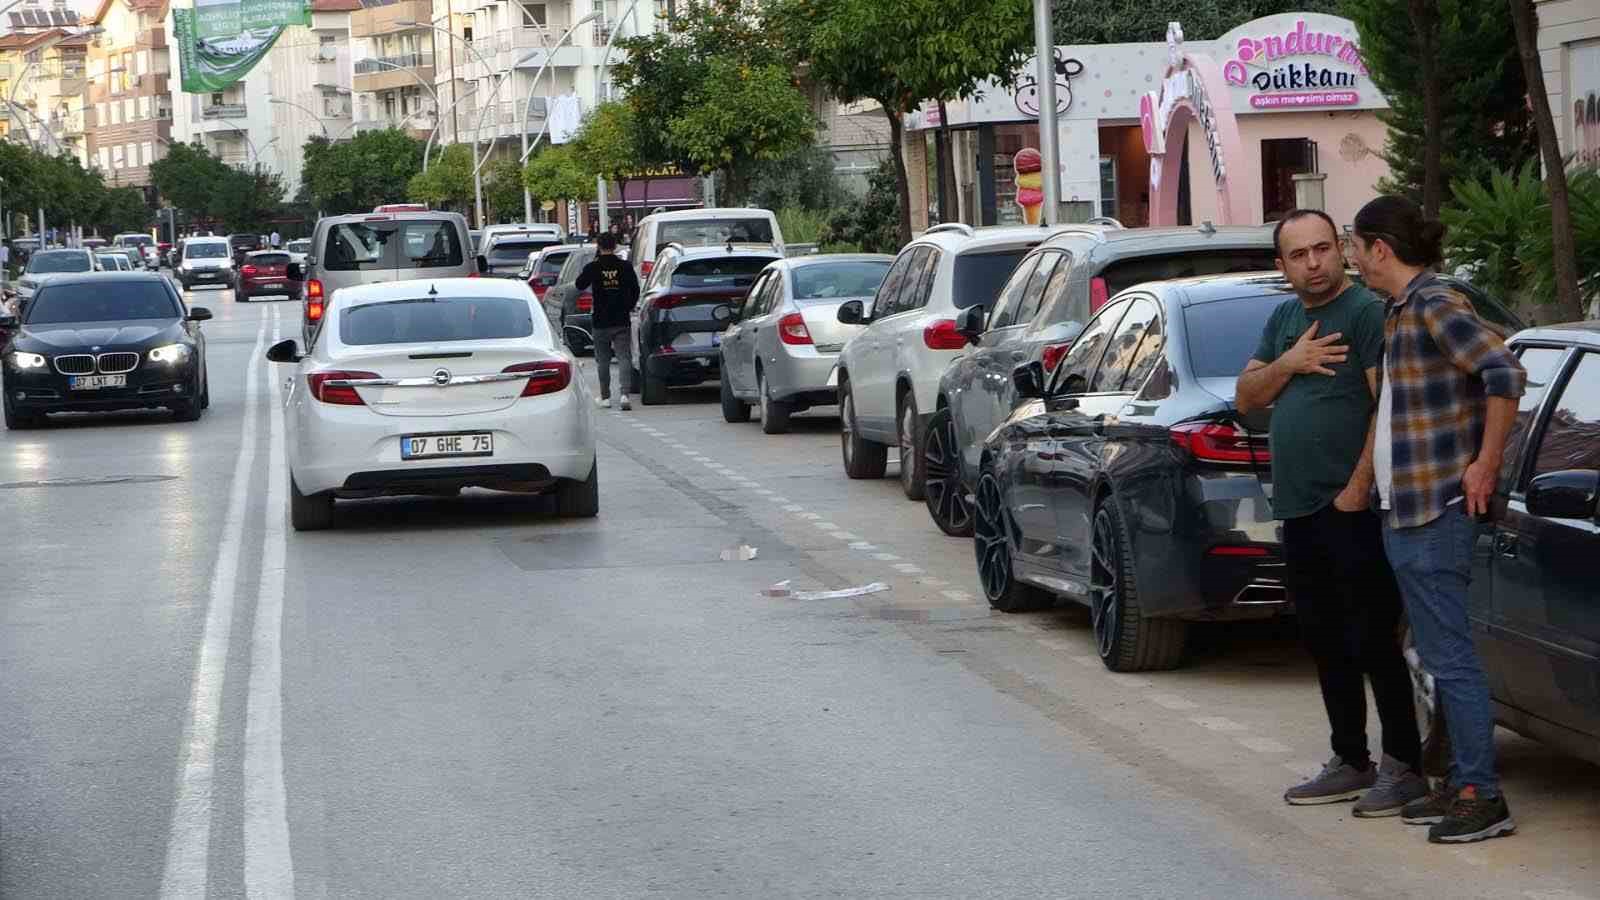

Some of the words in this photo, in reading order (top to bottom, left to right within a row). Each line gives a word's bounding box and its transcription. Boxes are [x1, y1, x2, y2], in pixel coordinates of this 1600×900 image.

[1326, 93, 1353, 102] olmaz
[113, 375, 124, 385] 77
[411, 438, 426, 454] 07
[436, 436, 462, 452] GHE
[472, 435, 489, 451] 75
